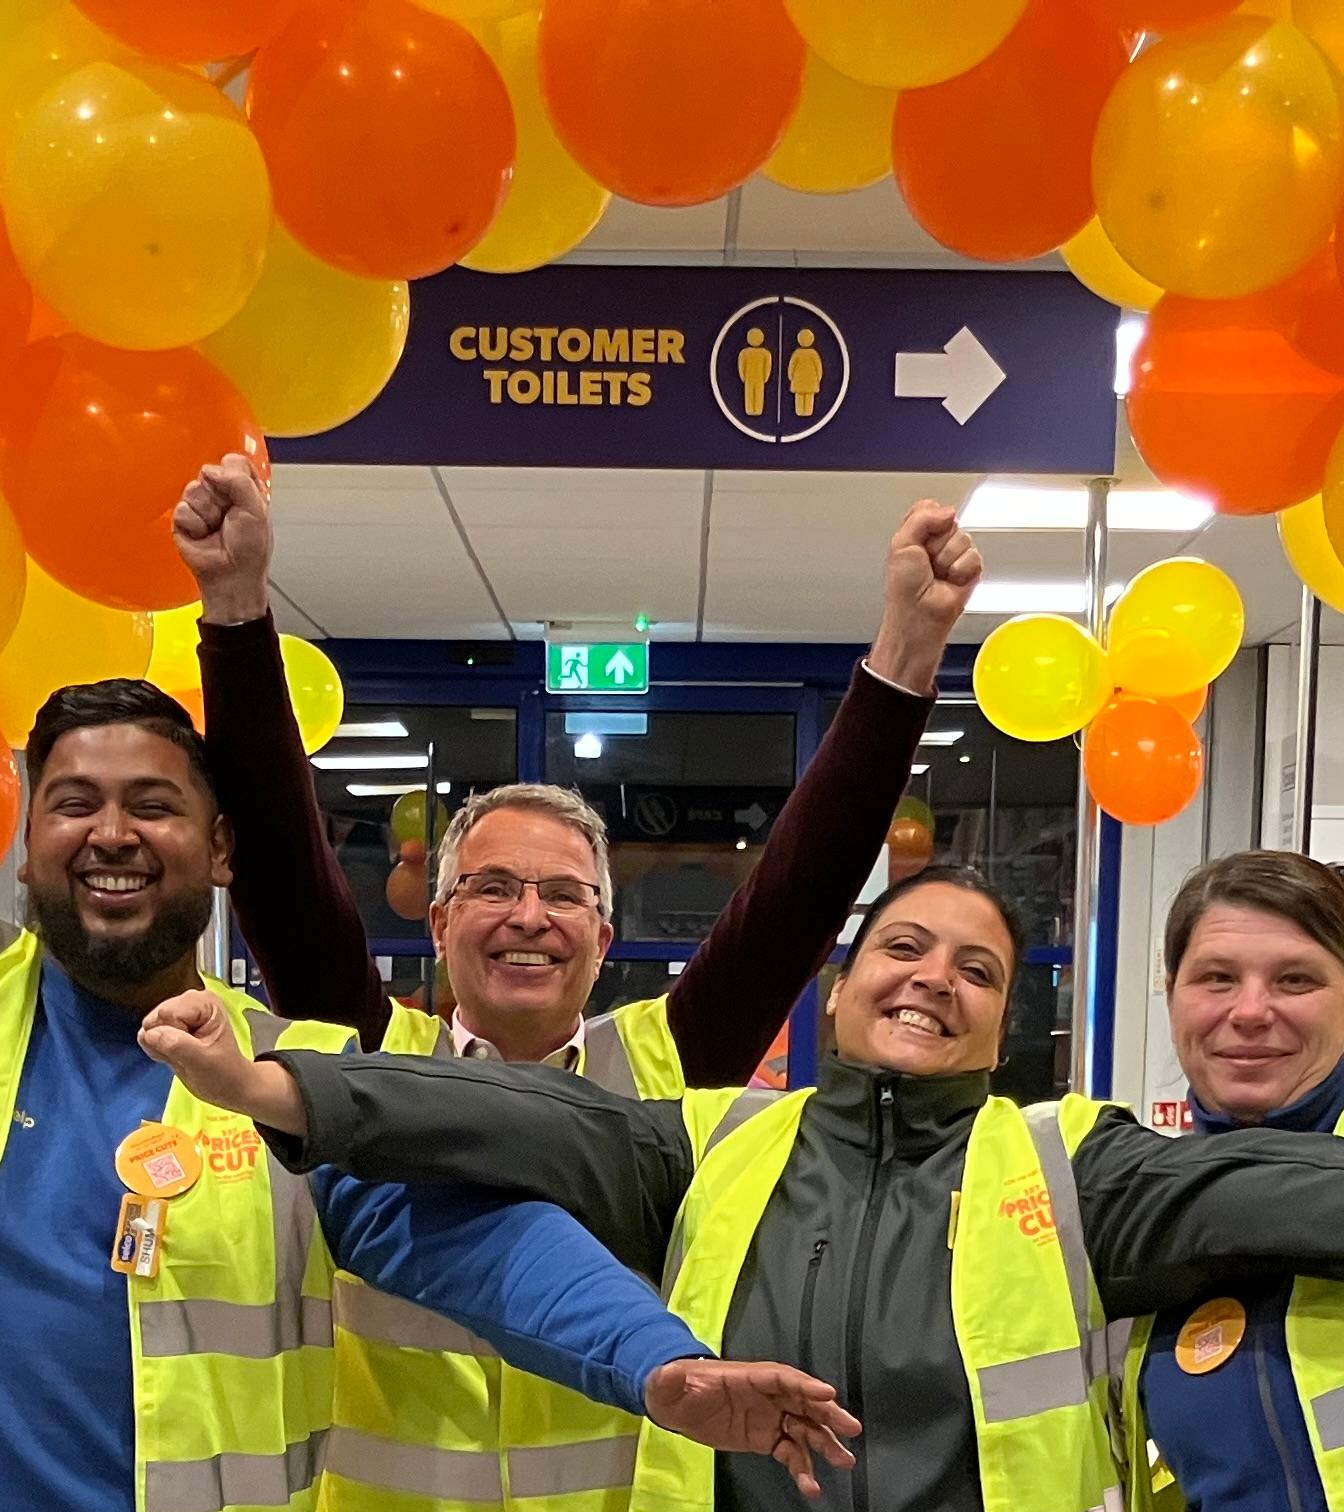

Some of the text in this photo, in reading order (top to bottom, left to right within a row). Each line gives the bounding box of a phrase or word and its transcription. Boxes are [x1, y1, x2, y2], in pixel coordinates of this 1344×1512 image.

[449, 326, 686, 363] CUSTOMER
[483, 370, 652, 406] TOILETS
[202, 1130, 261, 1151] PRICES
[208, 1146, 259, 1172] CUT
[1006, 1191, 1050, 1218] PRIC
[1019, 1210, 1055, 1236] CU
